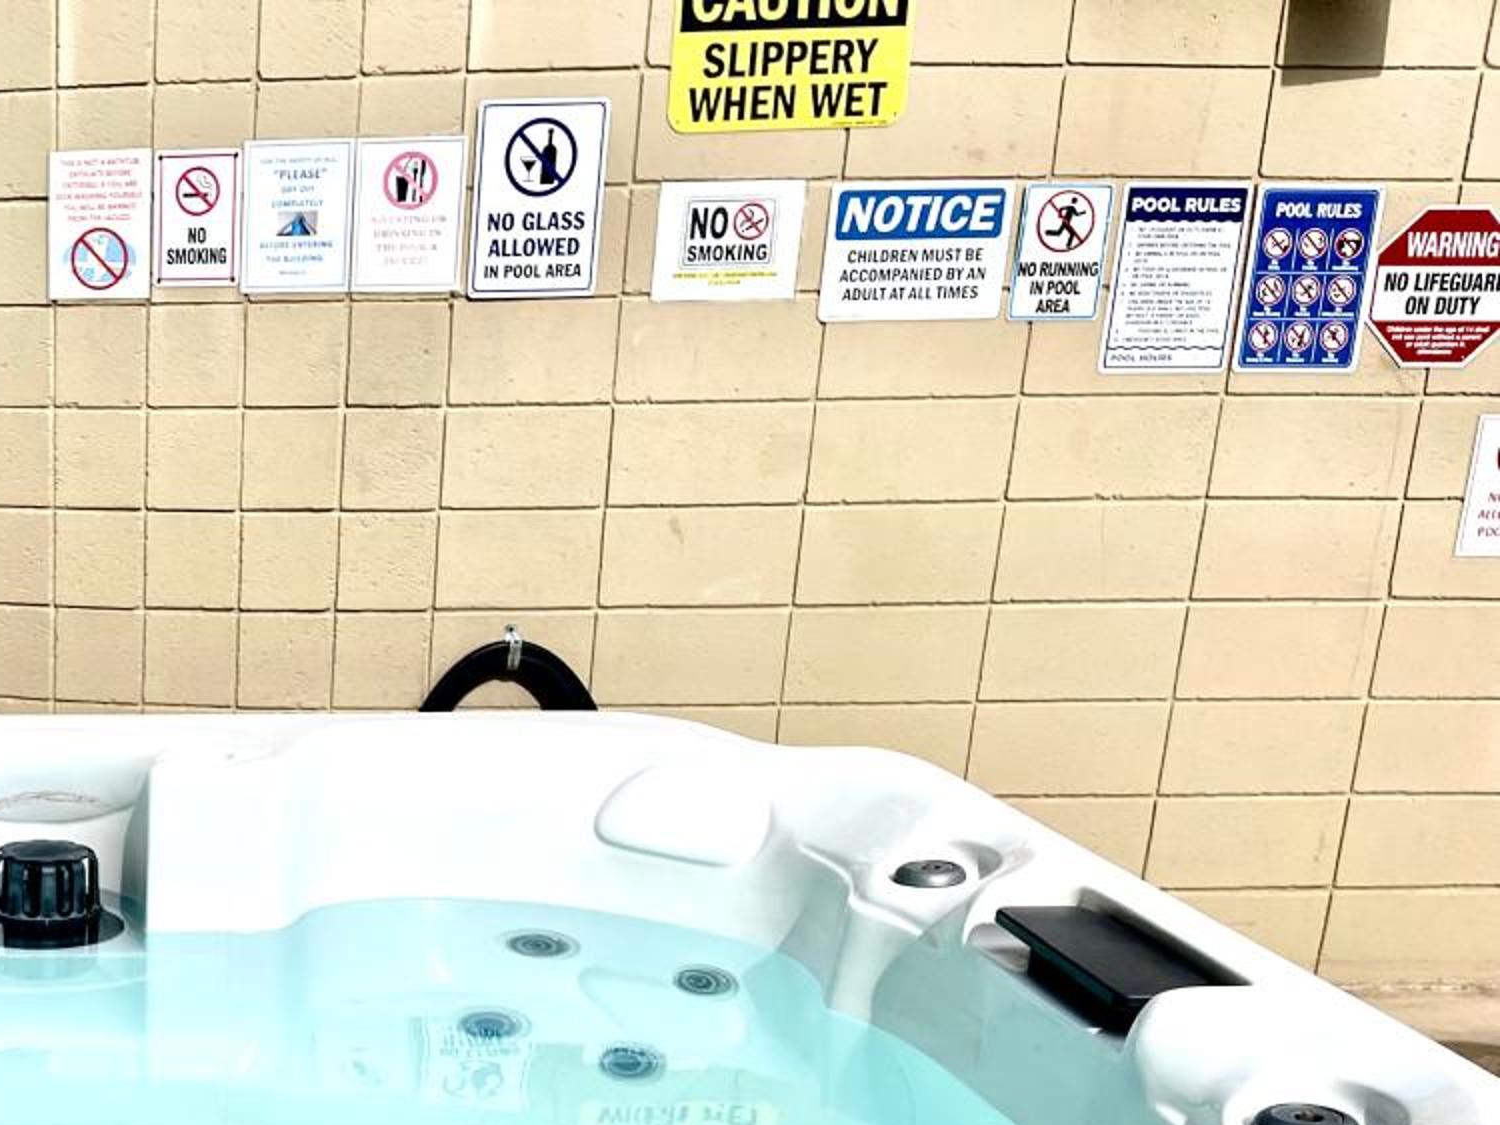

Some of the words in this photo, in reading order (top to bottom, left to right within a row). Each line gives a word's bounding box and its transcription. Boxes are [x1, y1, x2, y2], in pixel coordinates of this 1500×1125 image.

[703, 38, 879, 78] SLIPPERY
[689, 84, 796, 122] WHEN
[811, 82, 888, 118] WET
[1131, 197, 1181, 213] POOL
[1185, 197, 1242, 213] RULES
[1276, 202, 1314, 218] POOL
[1316, 202, 1363, 218] RULES
[487, 213, 515, 231] NO
[522, 211, 585, 230] GLASS
[841, 195, 1002, 233] NOTICE
[690, 206, 729, 240] NO
[188, 227, 206, 244] NO
[487, 238, 580, 257] ALLOWED
[687, 244, 768, 262] SMOKING
[1407, 231, 1500, 258] WARNING
[167, 248, 227, 265] SMOKING
[847, 249, 917, 263] CHILDREN
[921, 248, 961, 262] MUST
[965, 248, 984, 261] BE
[484, 265, 498, 278] IN
[504, 264, 540, 278] POOL
[545, 263, 581, 277] AREA
[840, 268, 943, 282] ACCOMPANIED
[946, 267, 962, 280] BY
[966, 267, 986, 280] AN
[1017, 262, 1037, 277] NO
[1039, 262, 1099, 277] RUNNING
[1030, 281, 1045, 295] IN
[1046, 281, 1081, 295] POOL
[1384, 272, 1409, 292] NO
[841, 287, 886, 301] ADULT
[889, 287, 906, 300] AT
[908, 286, 931, 299] ALL
[937, 286, 979, 299] TIMES
[1035, 299, 1071, 313] AREA
[1405, 296, 1430, 315] ON
[1434, 296, 1481, 315] DUTY
